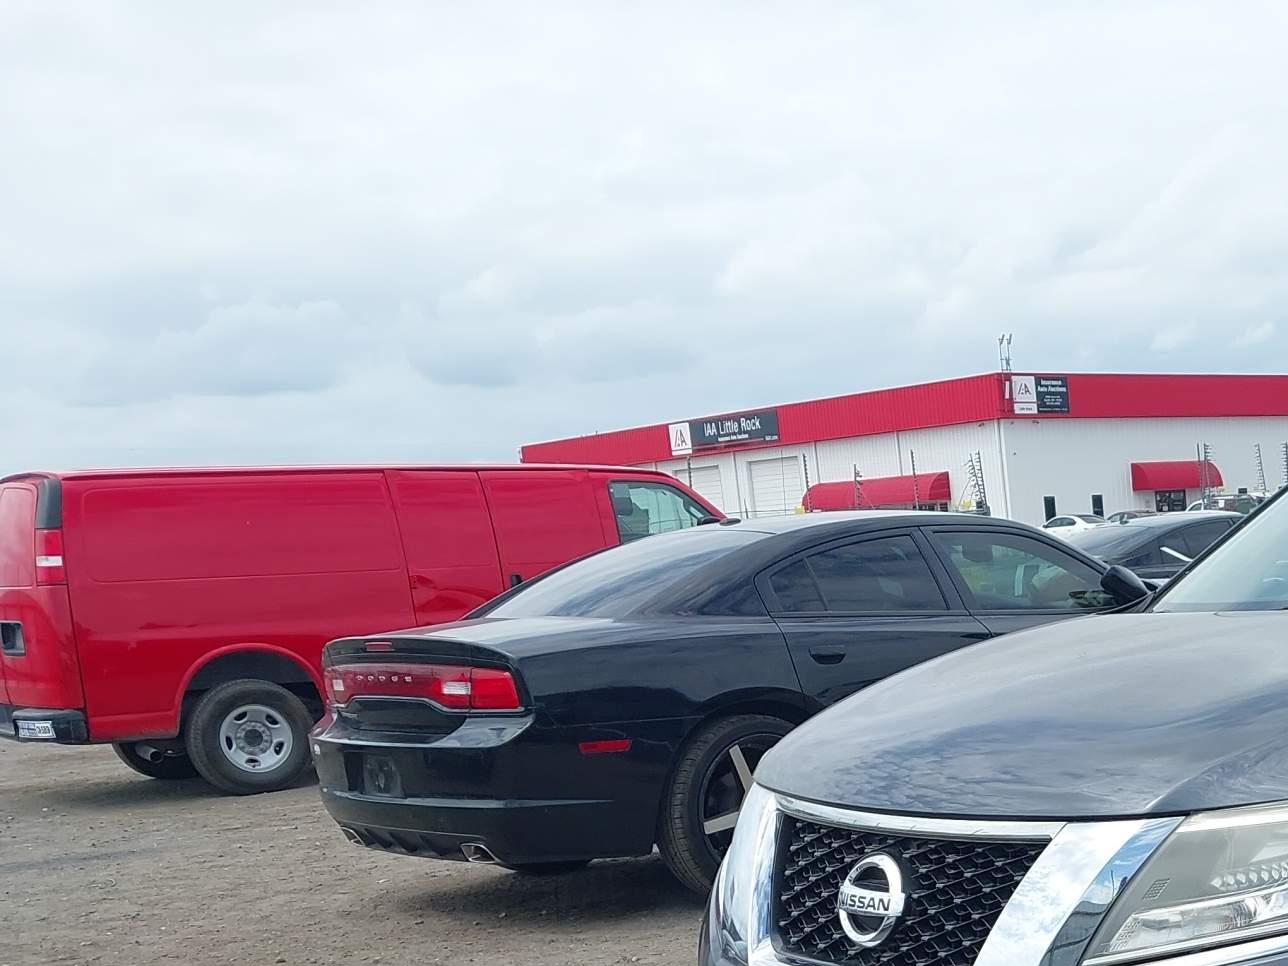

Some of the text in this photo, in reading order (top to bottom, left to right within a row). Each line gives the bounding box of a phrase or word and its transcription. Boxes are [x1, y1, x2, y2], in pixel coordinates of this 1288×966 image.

[704, 416, 760, 436] IAA Little Rock
[838, 890, 891, 912] NISSAN
